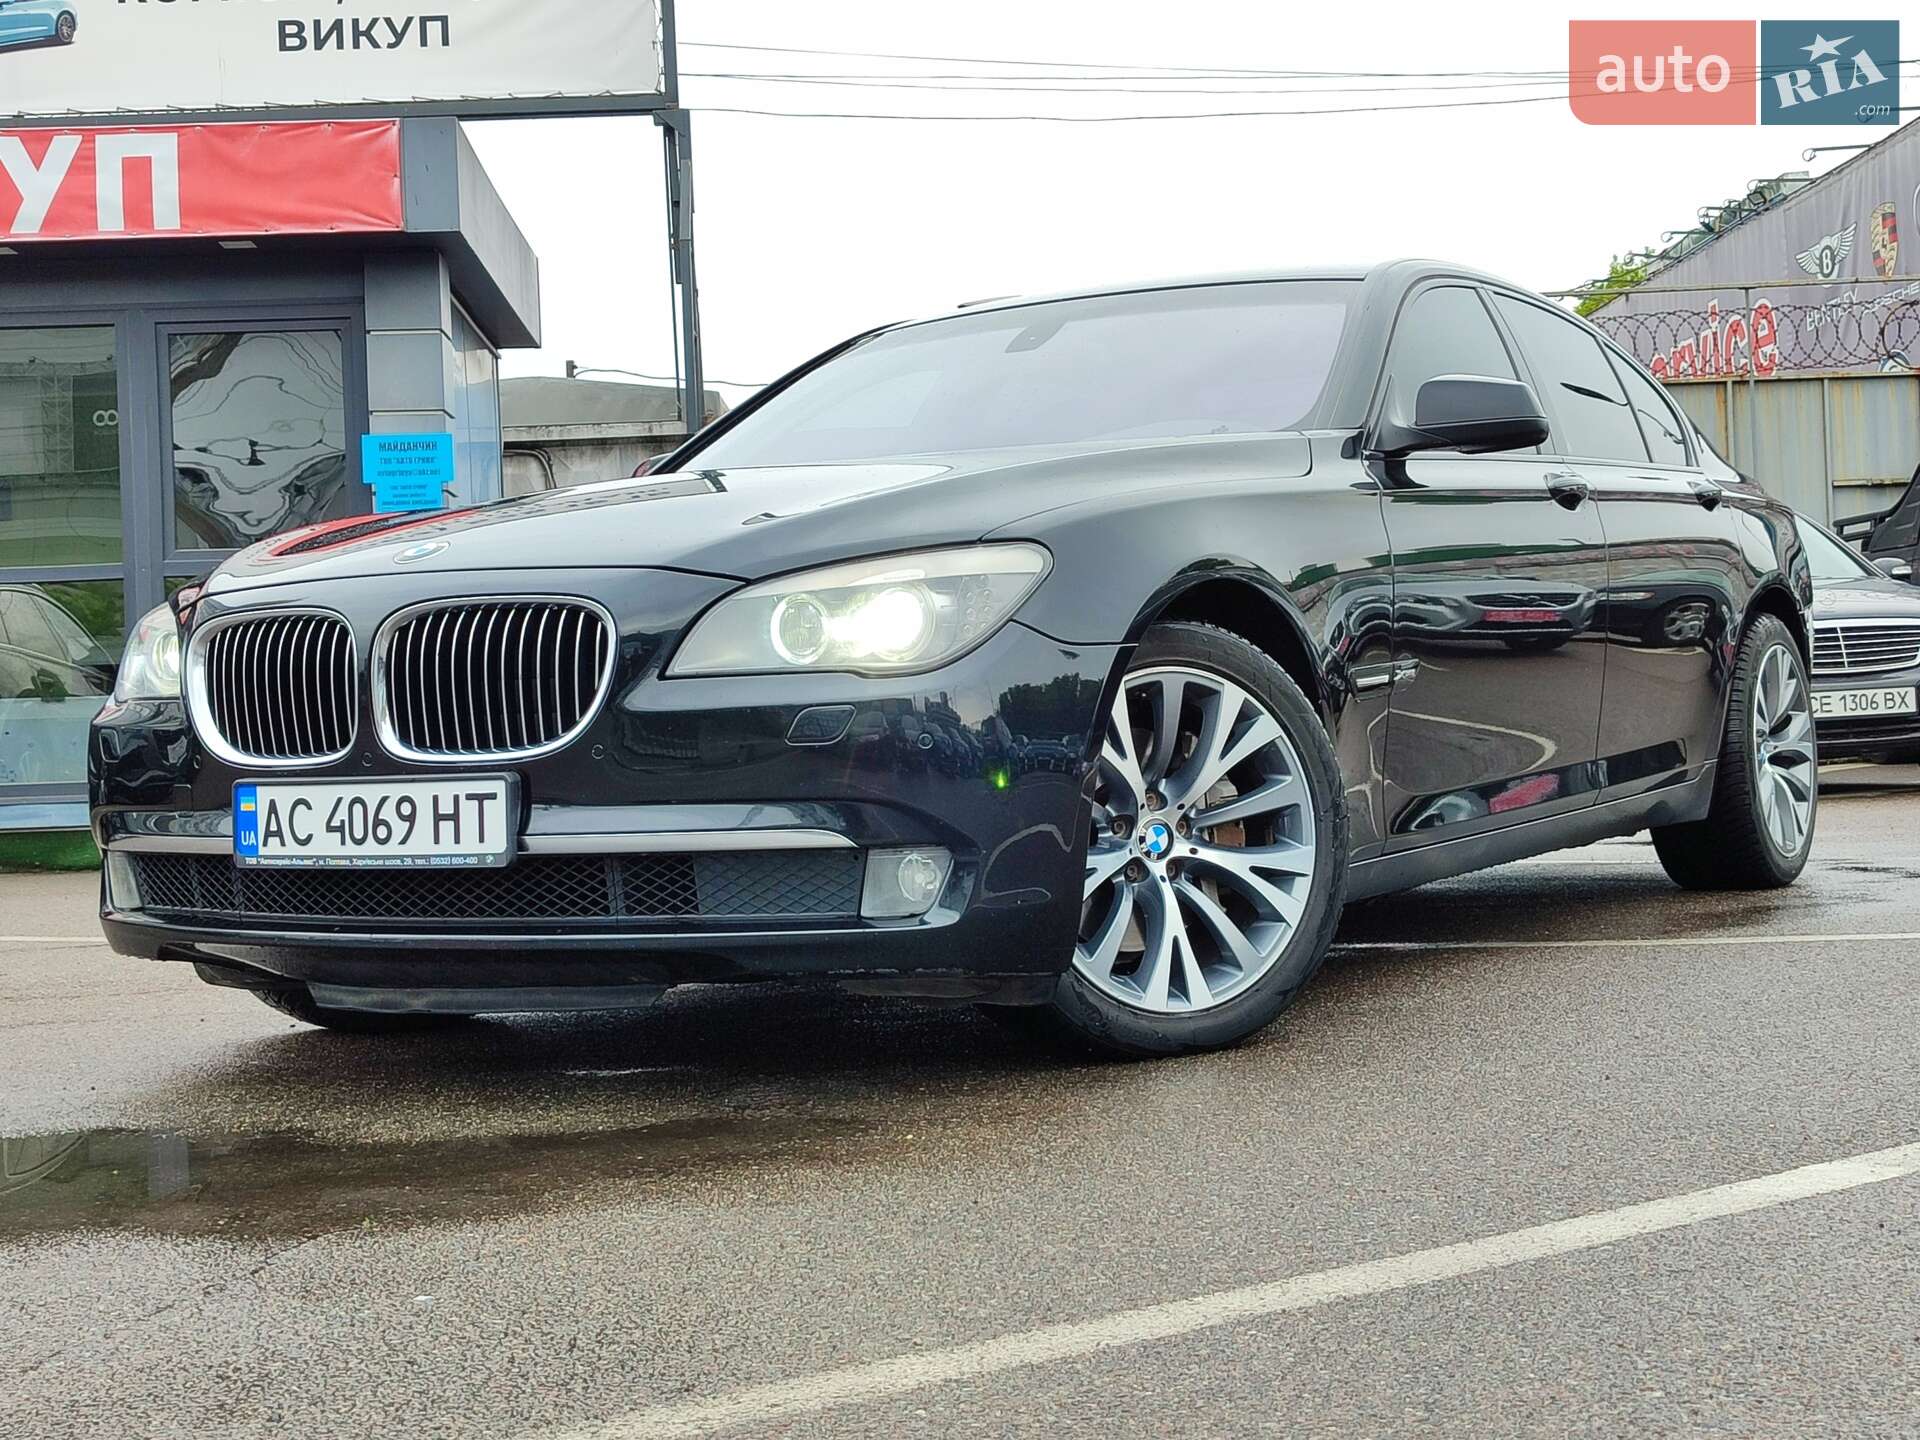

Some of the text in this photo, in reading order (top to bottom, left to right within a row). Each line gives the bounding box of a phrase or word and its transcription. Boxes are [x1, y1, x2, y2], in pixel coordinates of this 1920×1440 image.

[278, 15, 451, 52] ВИКУП
[1839, 693, 1879, 712] 1306
[1884, 691, 1909, 709] BX
[262, 792, 498, 847] AC 4069 HT
[241, 834, 257, 846] UA
